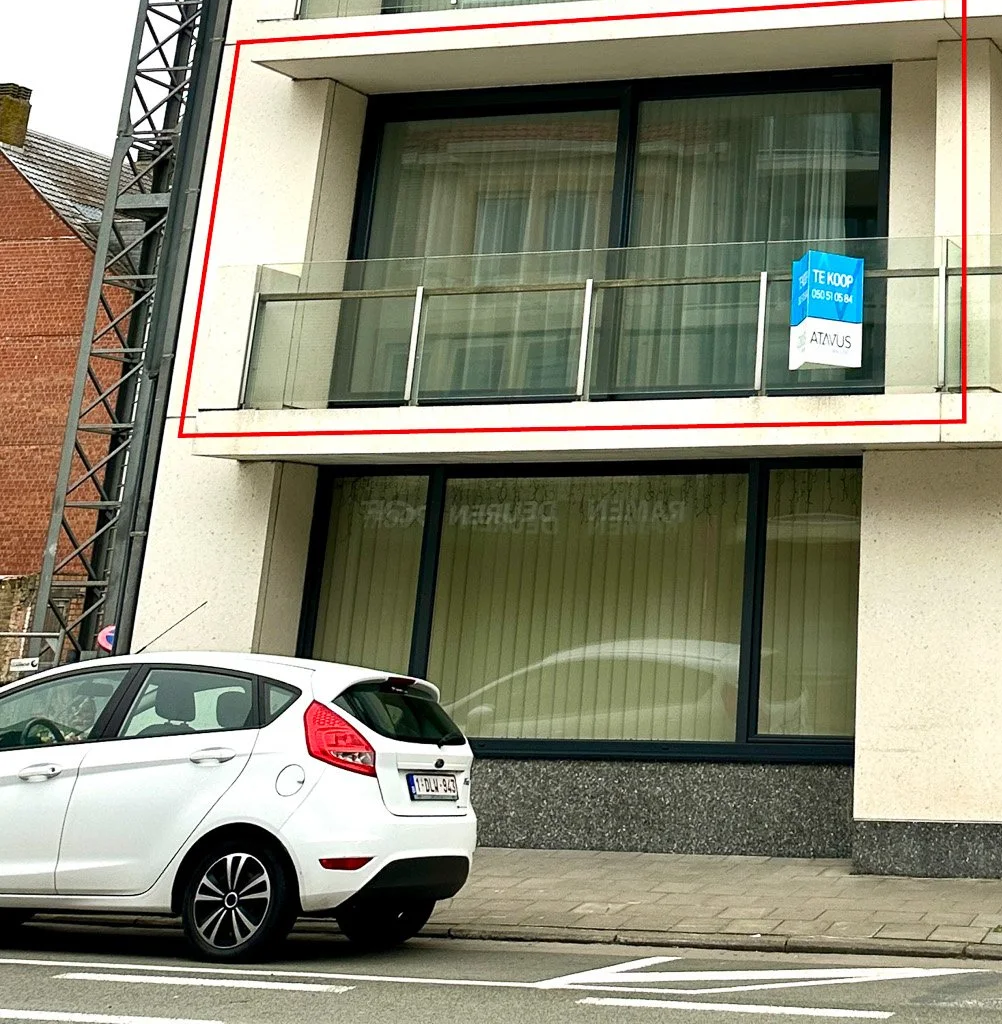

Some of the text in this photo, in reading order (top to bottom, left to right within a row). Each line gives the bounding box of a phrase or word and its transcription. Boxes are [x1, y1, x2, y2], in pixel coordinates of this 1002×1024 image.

[812, 268, 826, 283] TE
[827, 271, 854, 288] KOOP
[811, 288, 826, 300] 050
[834, 292, 844, 302] 05
[844, 294, 853, 304] 84
[810, 331, 852, 349] ATAVUS
